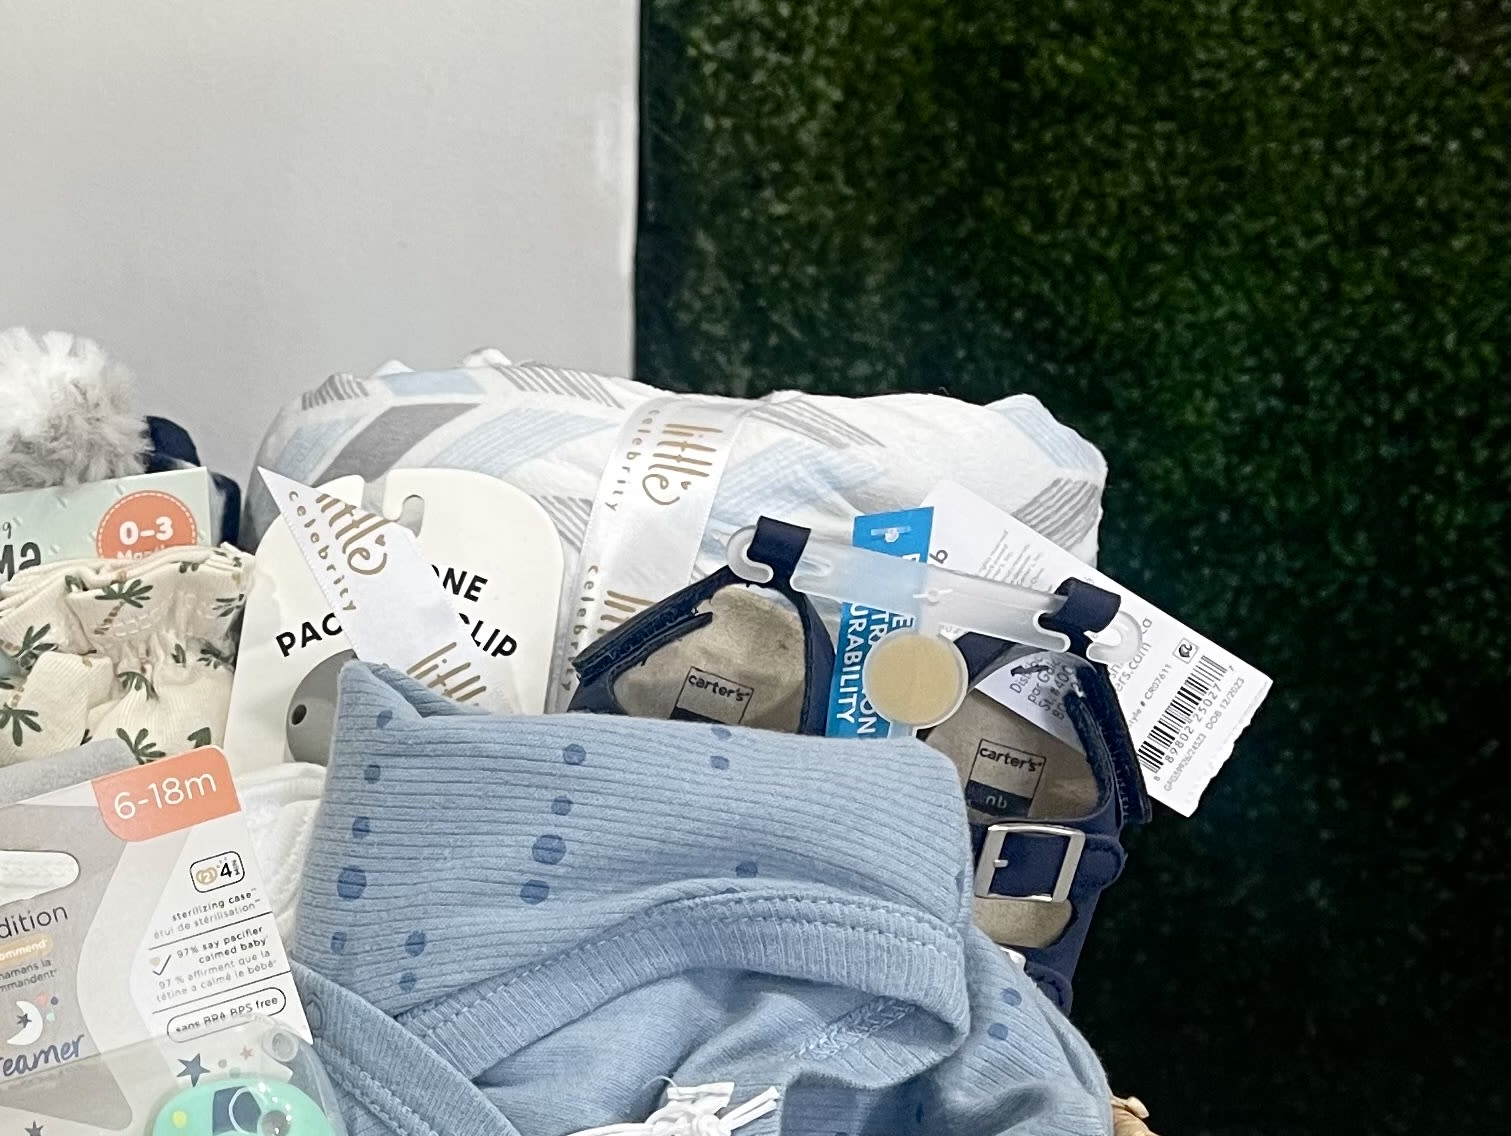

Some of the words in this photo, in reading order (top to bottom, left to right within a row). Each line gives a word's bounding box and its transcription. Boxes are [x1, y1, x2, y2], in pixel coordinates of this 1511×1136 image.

[641, 423, 724, 506] little
[119, 516, 174, 546] 0-3
[431, 563, 489, 603] NE
[458, 612, 518, 660] LIP
[836, 602, 869, 724] URABILITY
[688, 674, 745, 702] carter's
[979, 747, 1037, 773] carter's
[113, 772, 218, 820] 6-18m
[985, 794, 1009, 809] nb
[171, 900, 225, 922] sterilizing
[177, 921, 191, 933] de
[202, 938, 220, 951] say
[223, 925, 264, 946] pacifier
[41, 958, 52, 968] la
[198, 946, 237, 964] calmed
[240, 936, 268, 952] baby
[187, 958, 236, 981] affirment
[238, 953, 258, 966] que
[256, 996, 279, 1010] free
